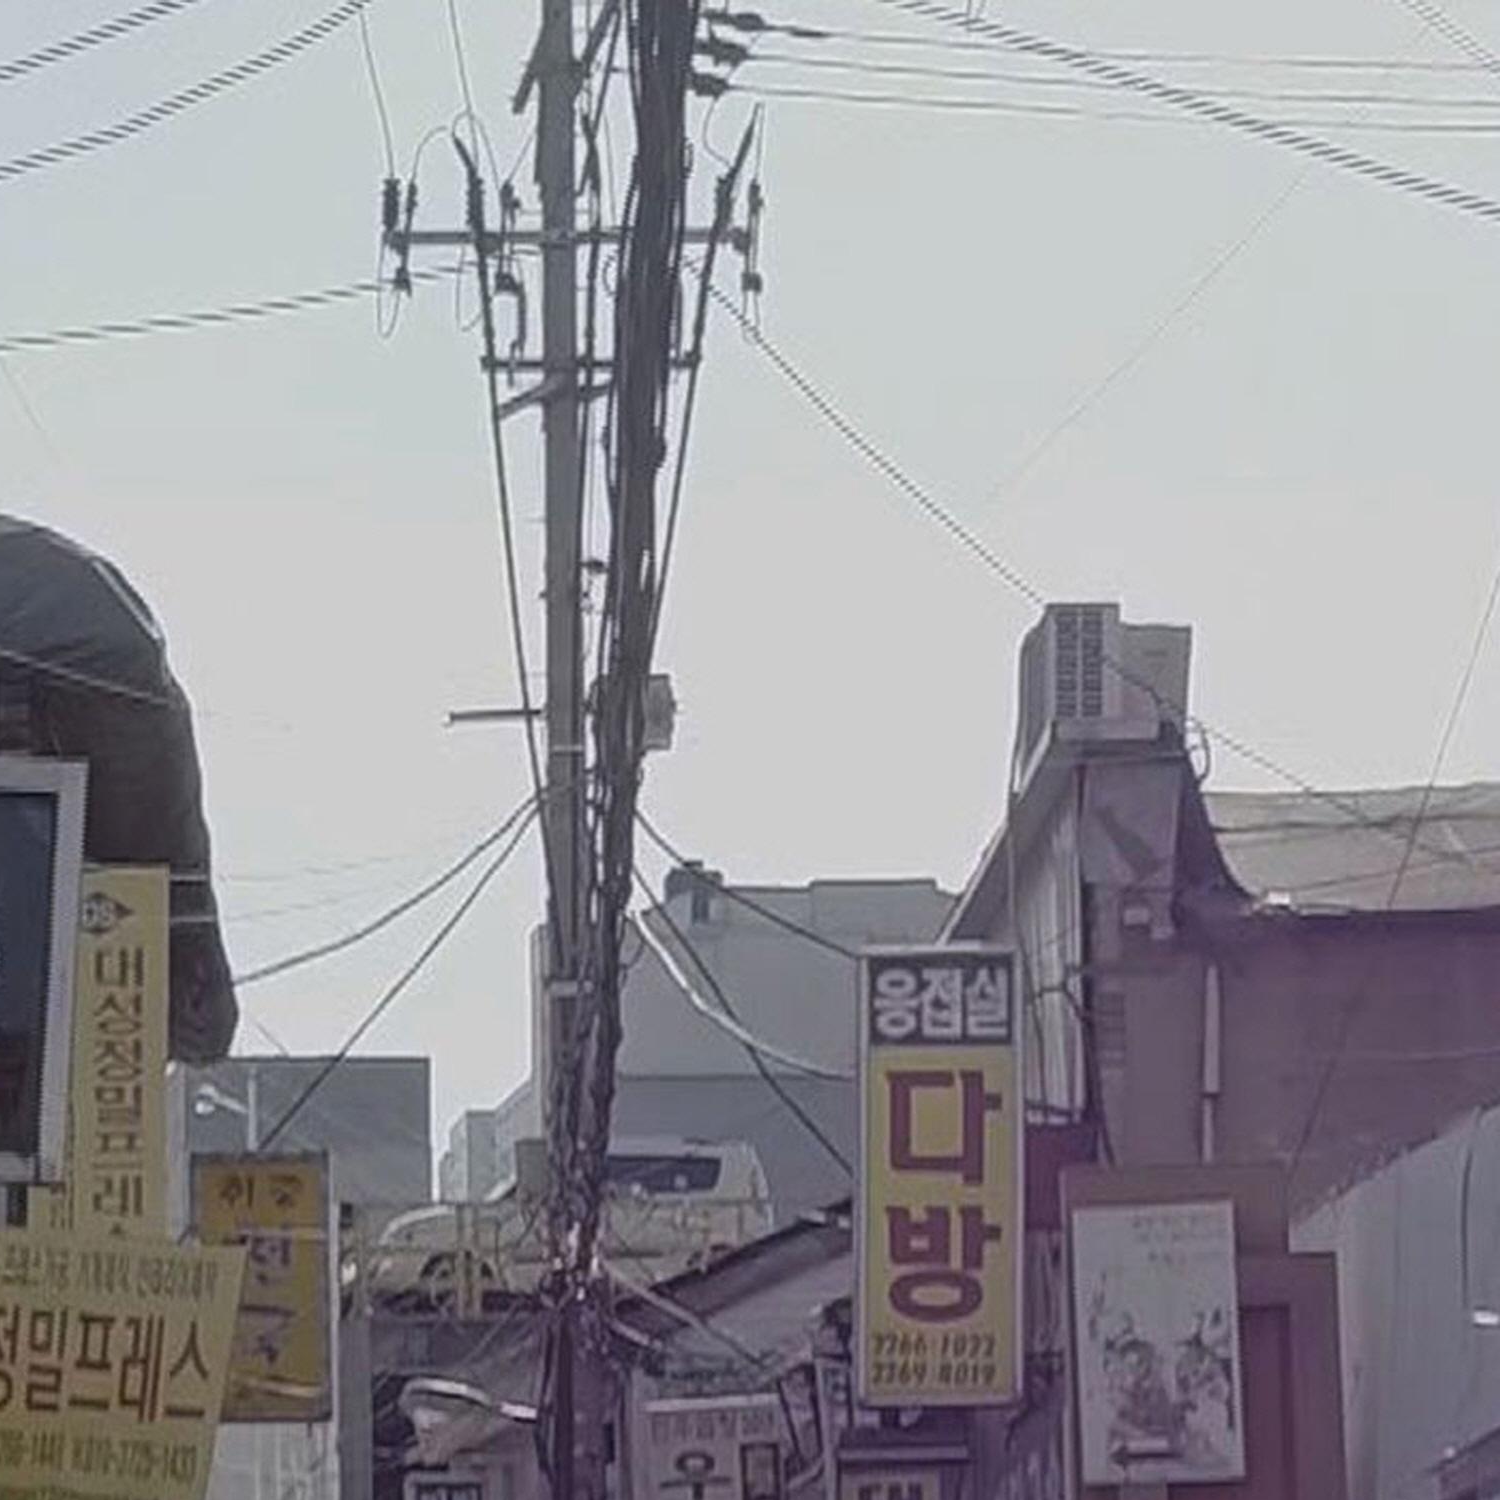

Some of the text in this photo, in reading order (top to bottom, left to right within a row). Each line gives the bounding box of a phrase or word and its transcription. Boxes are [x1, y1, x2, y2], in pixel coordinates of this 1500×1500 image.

[92, 945, 145, 1238] 대성정밀프레
[873, 966, 1008, 1039] 응접실
[885, 1068, 1003, 1322] 다방
